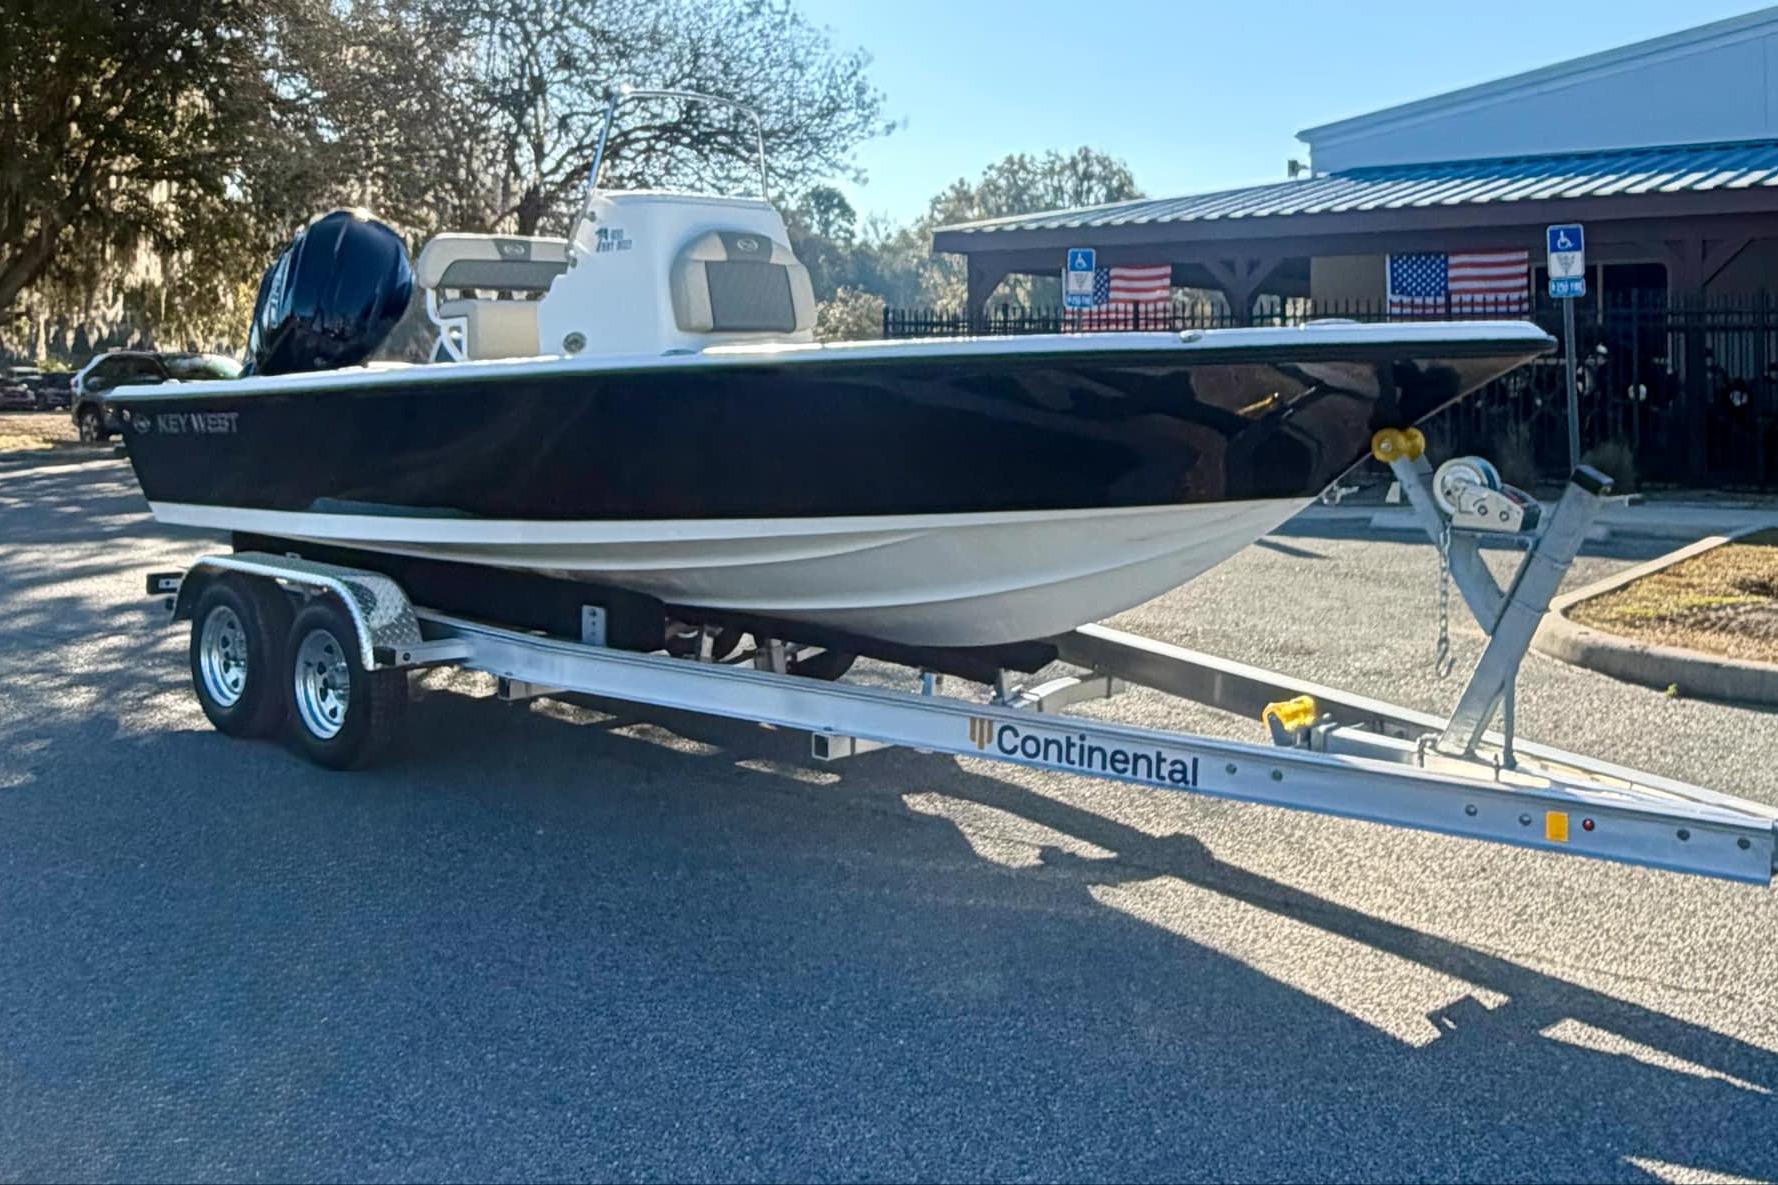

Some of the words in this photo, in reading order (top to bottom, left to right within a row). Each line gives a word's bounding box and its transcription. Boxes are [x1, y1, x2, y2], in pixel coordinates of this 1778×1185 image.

[157, 413, 189, 433] KEY
[190, 412, 239, 433] WEST
[997, 724, 1199, 787] Continental
